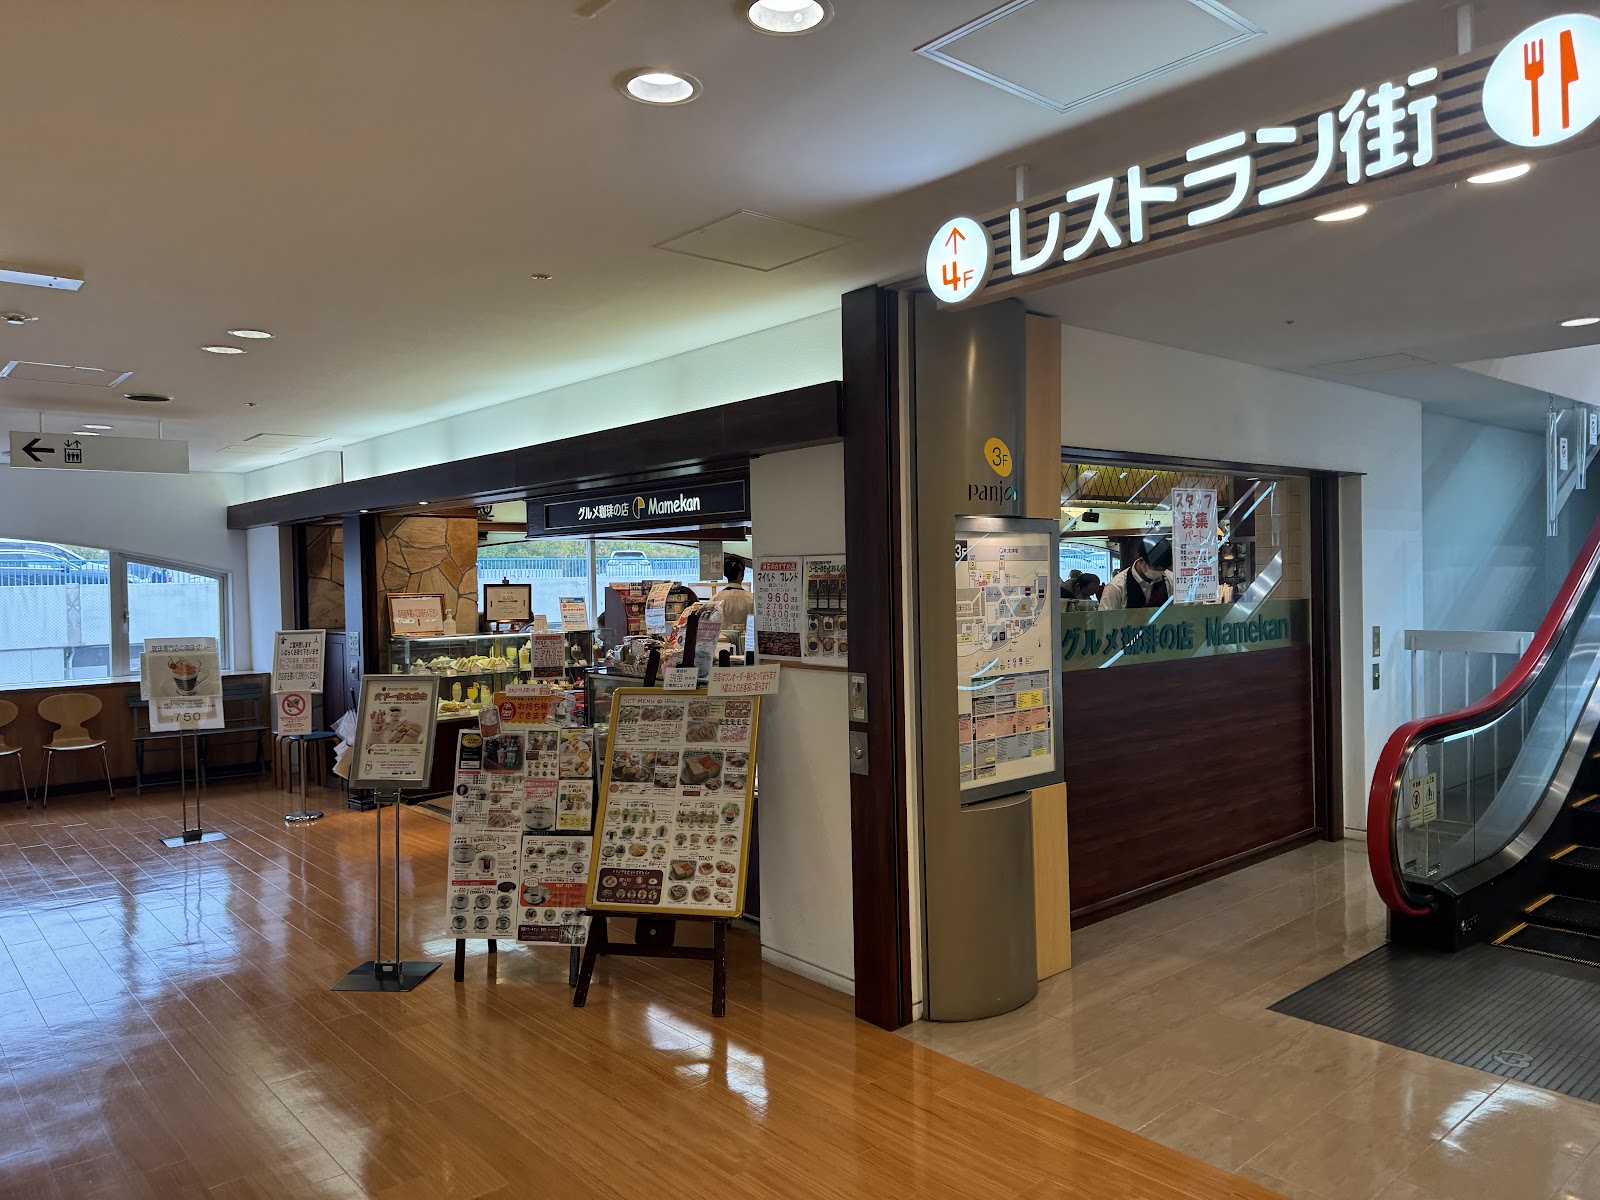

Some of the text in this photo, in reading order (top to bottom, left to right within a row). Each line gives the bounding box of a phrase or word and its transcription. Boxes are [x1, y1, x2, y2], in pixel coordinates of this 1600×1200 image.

[1009, 67, 1439, 276] レストラン街
[942, 261, 974, 291] 4F
[992, 446, 1009, 467] 3F
[968, 480, 1017, 506] panjo
[1175, 492, 1212, 509] スタッフ
[577, 493, 701, 521] グルメ珈琲の店 Mamekan
[1181, 511, 1209, 529] 募集
[1184, 530, 1205, 542] パート
[757, 571, 776, 583] マイルド
[1061, 613, 1289, 661] グルメ珈琲の店 Mamekan
[517, 711, 548, 720] できます
